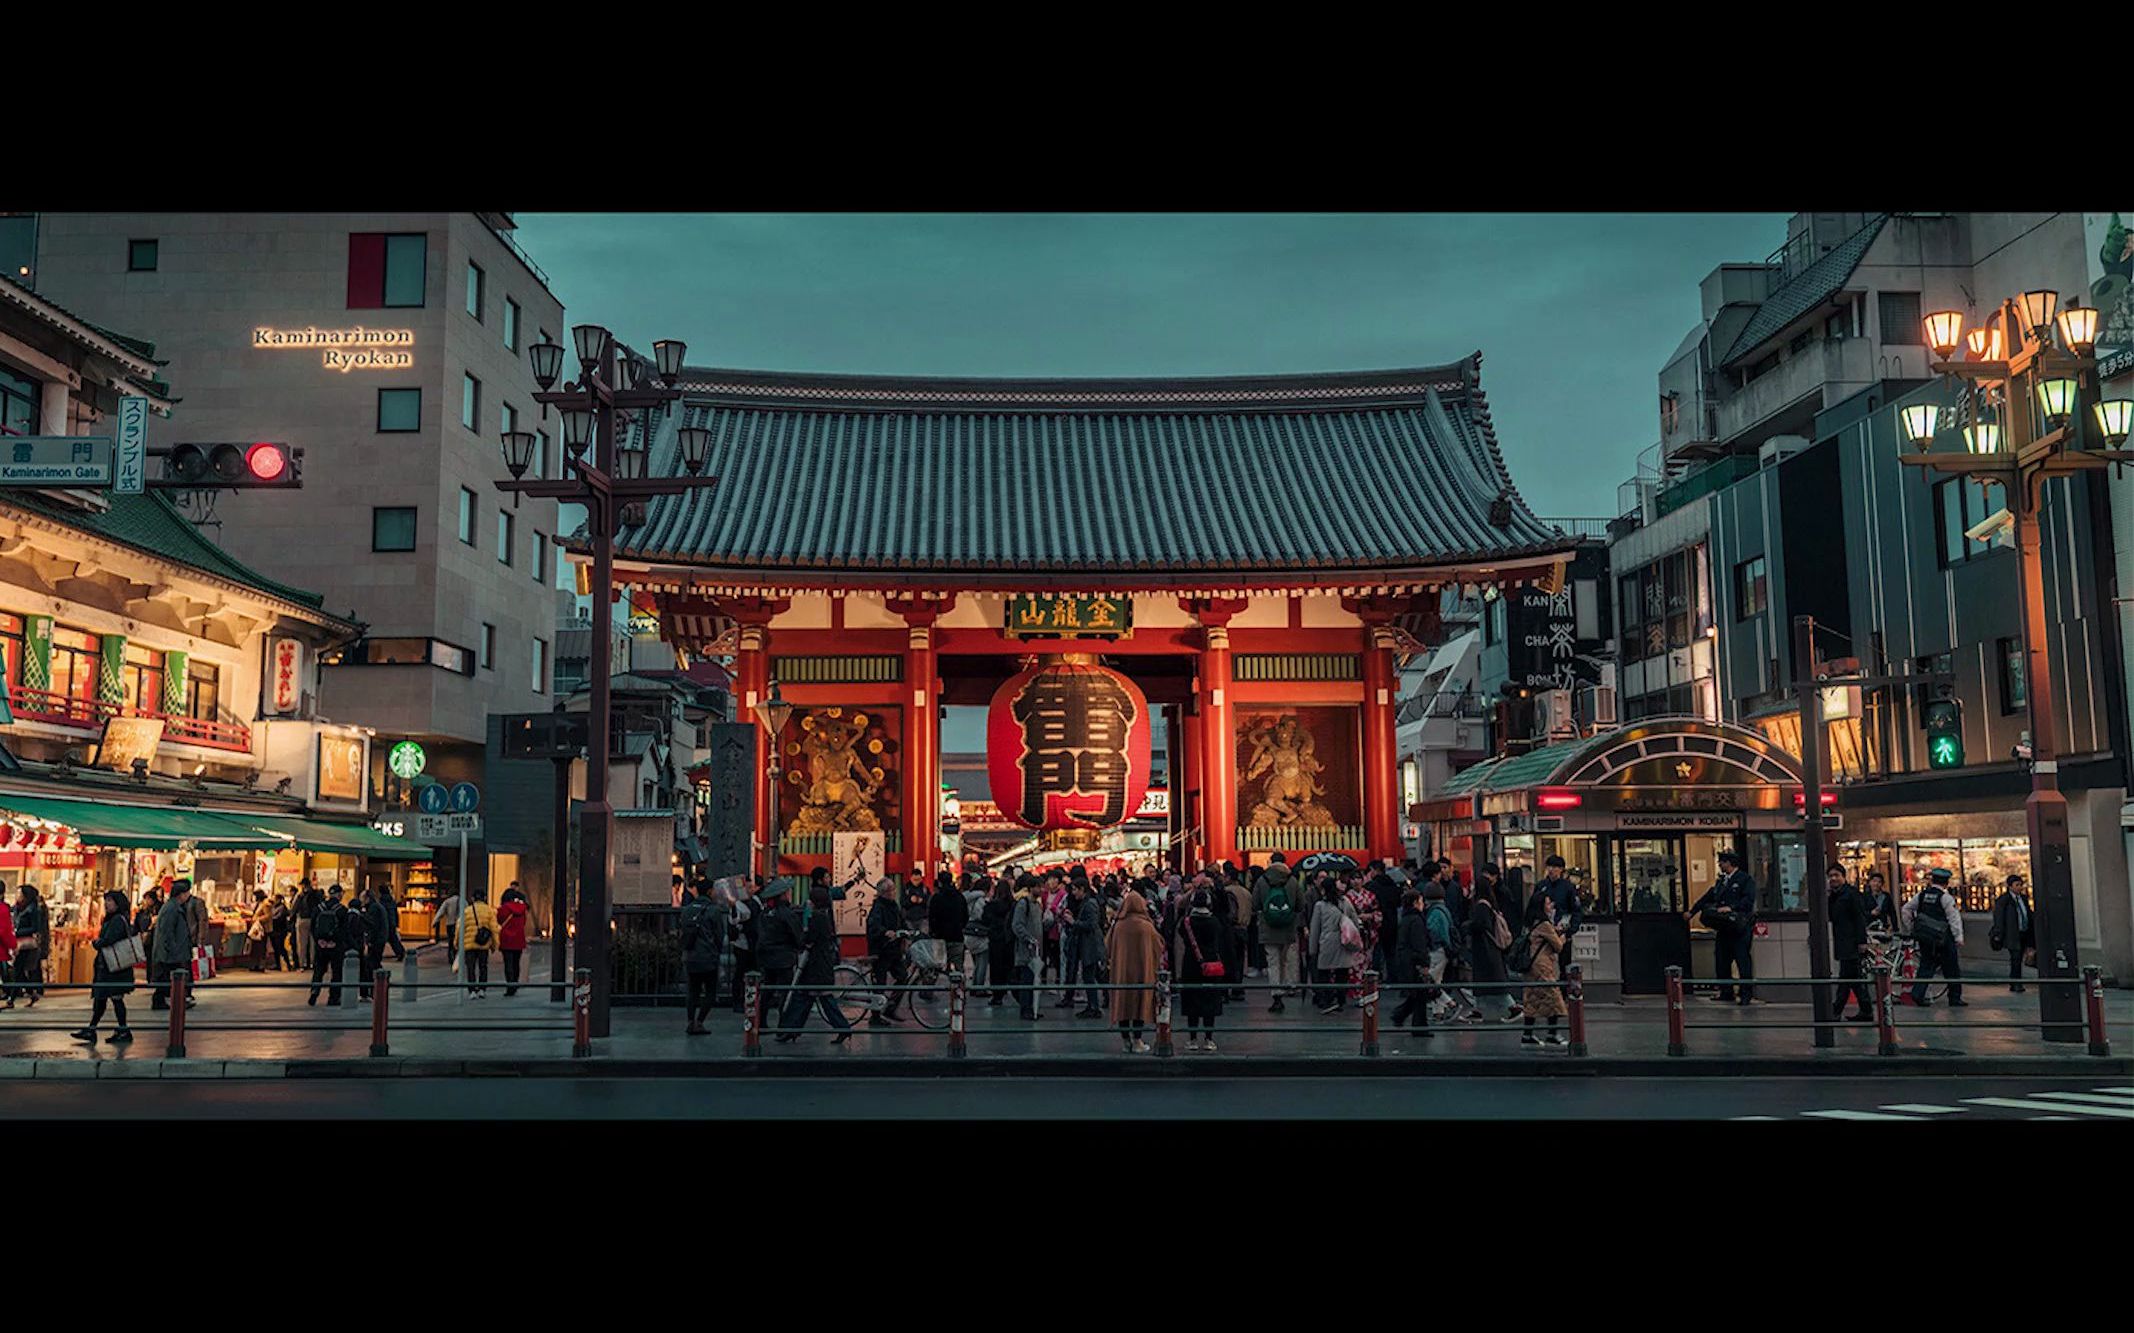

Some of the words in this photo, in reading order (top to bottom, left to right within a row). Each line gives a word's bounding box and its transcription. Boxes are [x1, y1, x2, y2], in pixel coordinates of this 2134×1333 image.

[253, 327, 411, 345] Kaminarimon
[325, 350, 410, 369] Ryokan
[121, 400, 142, 490] スクランブル式
[2, 466, 71, 478] Kaminarimon
[75, 466, 100, 478] Gate
[1523, 595, 1549, 607] KAN
[1524, 635, 1550, 647] CHA
[1623, 815, 1694, 826] KAMINARIMON
[1698, 815, 1733, 826] KOBAN
